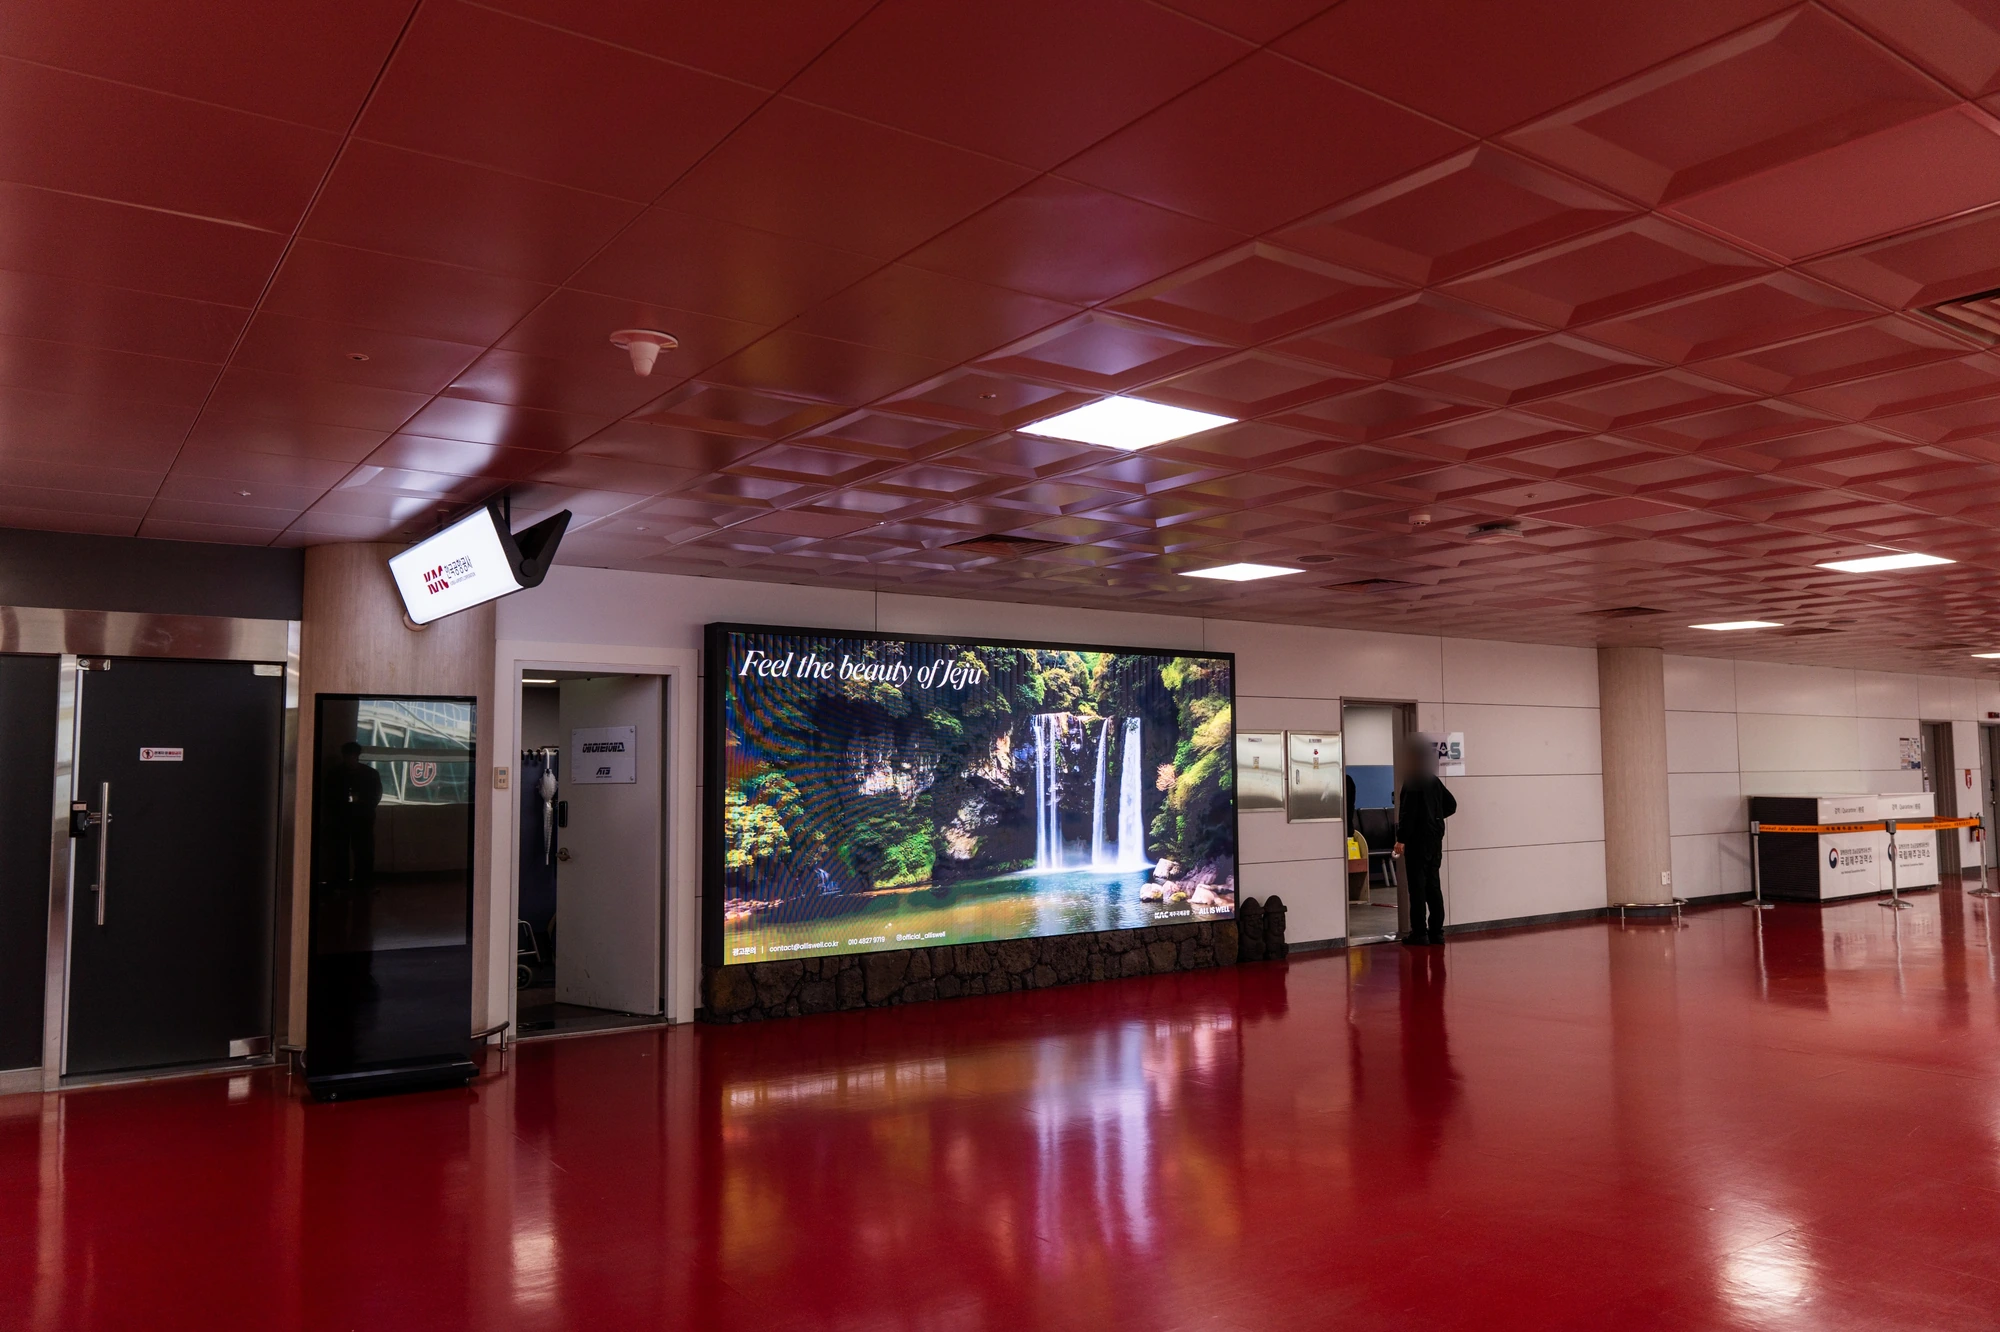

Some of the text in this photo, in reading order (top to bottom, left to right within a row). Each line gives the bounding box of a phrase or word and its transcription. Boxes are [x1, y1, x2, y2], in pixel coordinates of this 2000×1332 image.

[739, 650, 983, 690] Feel the beauty of Jeju
[1840, 854, 1872, 866] 국립제주검역소
[1899, 849, 1930, 859] 국립제주검역소
[1199, 907, 1209, 915] ALL
[769, 940, 839, 952] contact@alliswell.co.kr
